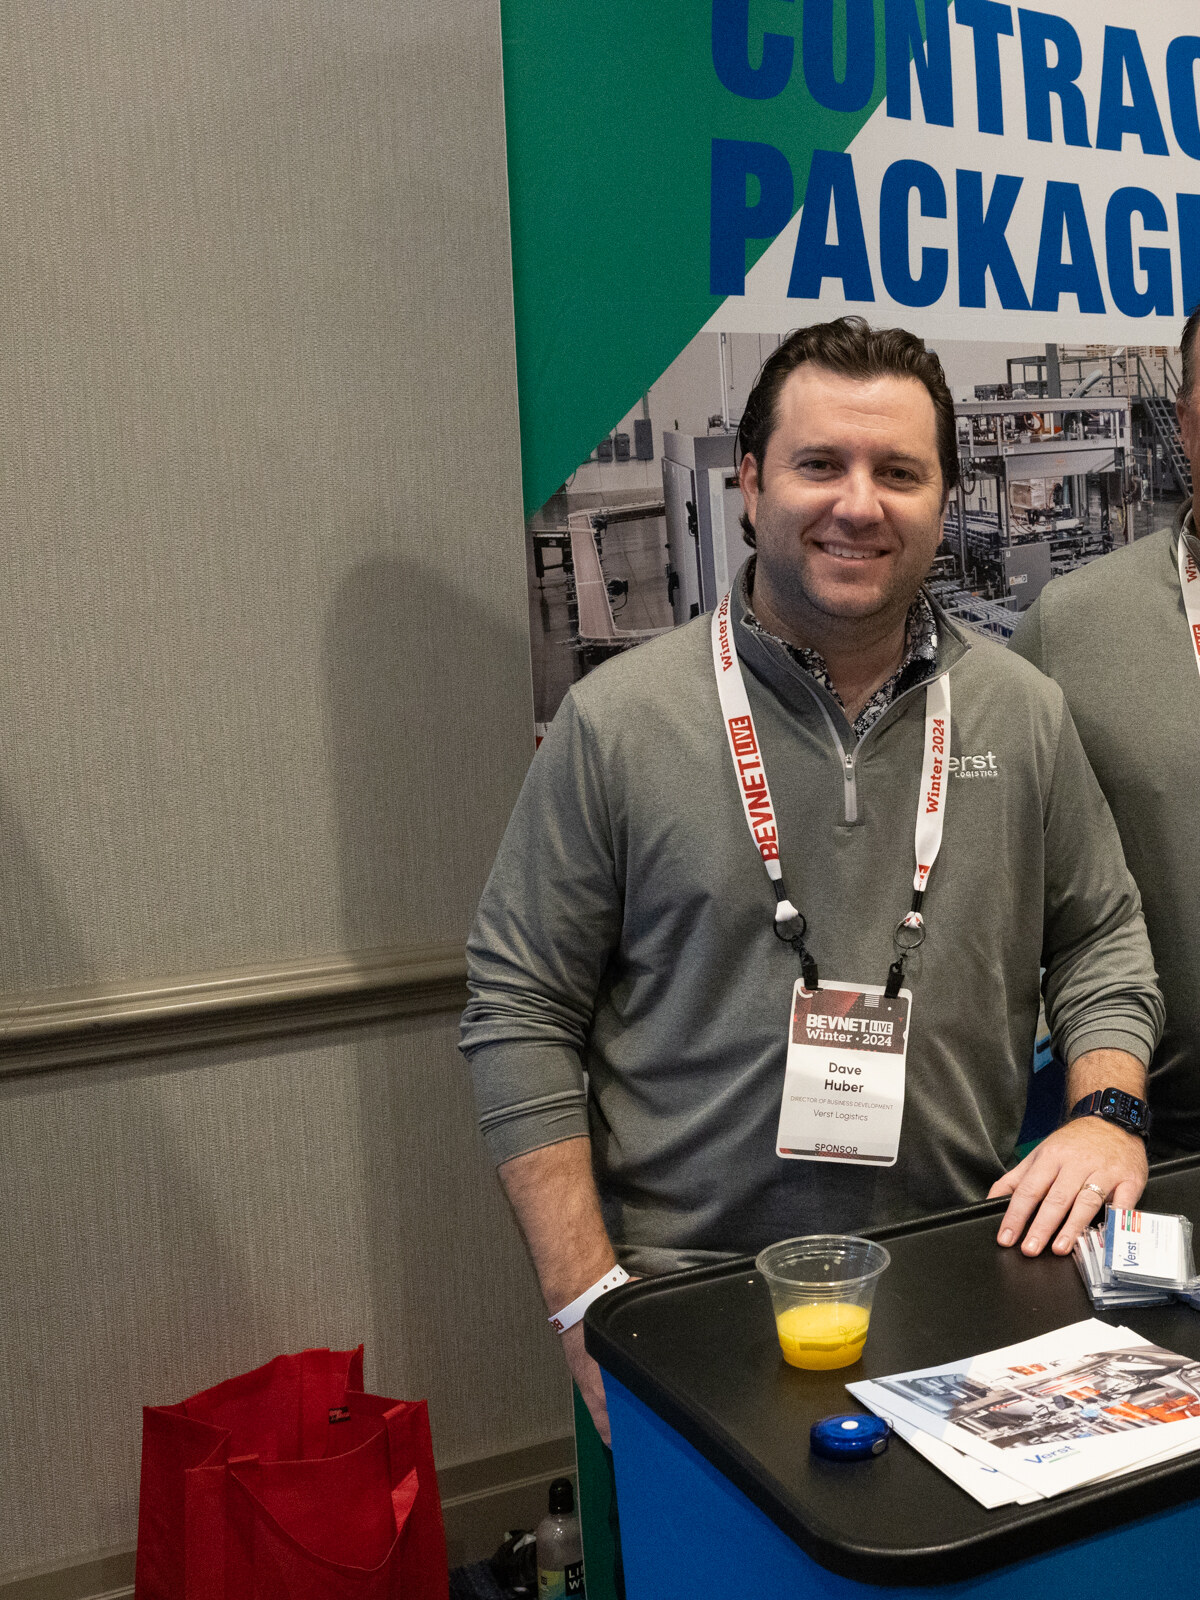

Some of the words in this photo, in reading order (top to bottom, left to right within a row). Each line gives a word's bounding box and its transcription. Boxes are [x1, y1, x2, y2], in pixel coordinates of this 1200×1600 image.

[718, 619, 733, 672] Winter
[728, 715, 758, 757] LIVE
[932, 718, 945, 755] 2024
[948, 751, 998, 772] erst
[954, 770, 998, 778] LOGISTICS
[926, 756, 942, 814] Winter
[869, 1020, 894, 1034] LIVE
[806, 1028, 852, 1042] Winter
[862, 1034, 892, 1046] 2024
[828, 1062, 862, 1076] Dave
[824, 1079, 864, 1093] Huber
[826, 1099, 854, 1107] BUSINESS
[854, 1102, 894, 1110] DEVELOPMENT
[814, 1110, 834, 1118] Verst
[835, 1111, 868, 1122] Logistics
[814, 1144, 858, 1154] SPONSOR
[1123, 1241, 1139, 1267] Verst
[1024, 1446, 1074, 1464] Verst
